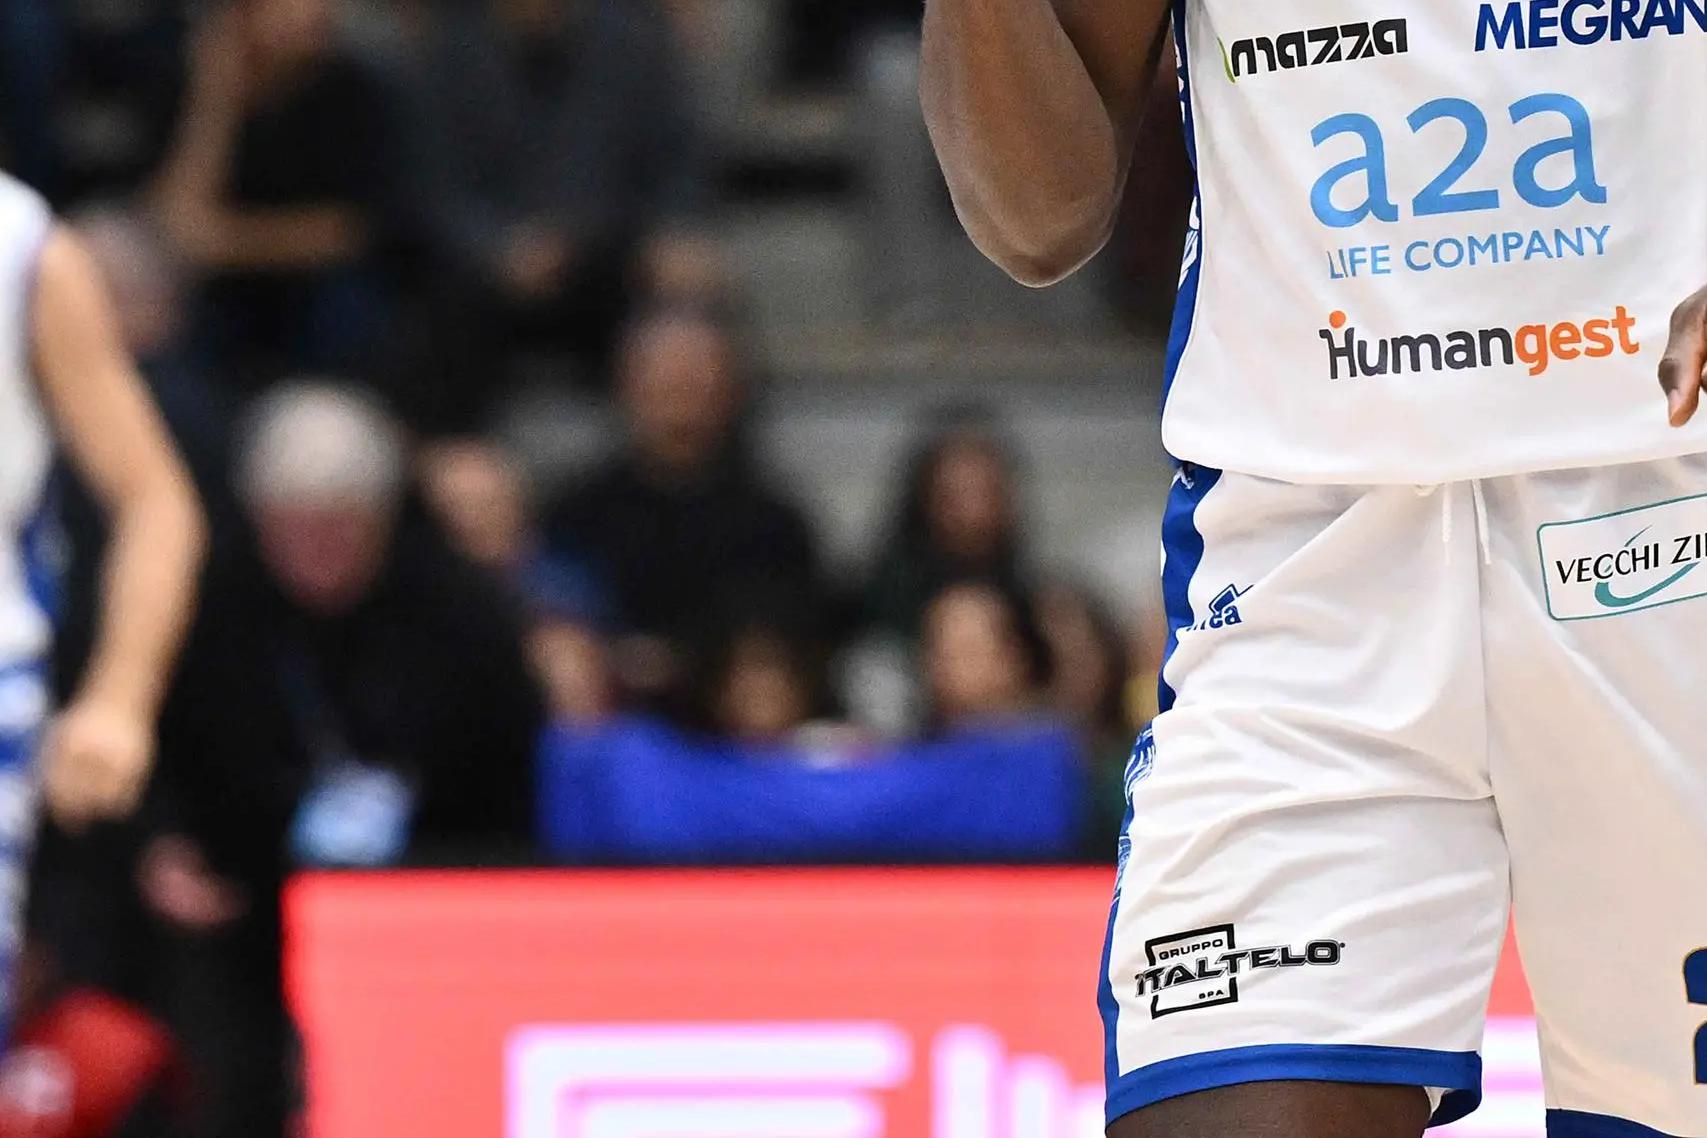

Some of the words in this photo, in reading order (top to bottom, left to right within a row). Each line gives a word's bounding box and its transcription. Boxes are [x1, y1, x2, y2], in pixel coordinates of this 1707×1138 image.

[1310, 93, 1607, 229] a2a
[1328, 245, 1391, 279] LIFE
[1405, 225, 1611, 271] COMPANY
[1319, 305, 1639, 380] Humangest
[1555, 543, 1660, 584] VECCHI
[1159, 938, 1224, 961] GRUPPO
[1198, 989, 1225, 1000] SPA
